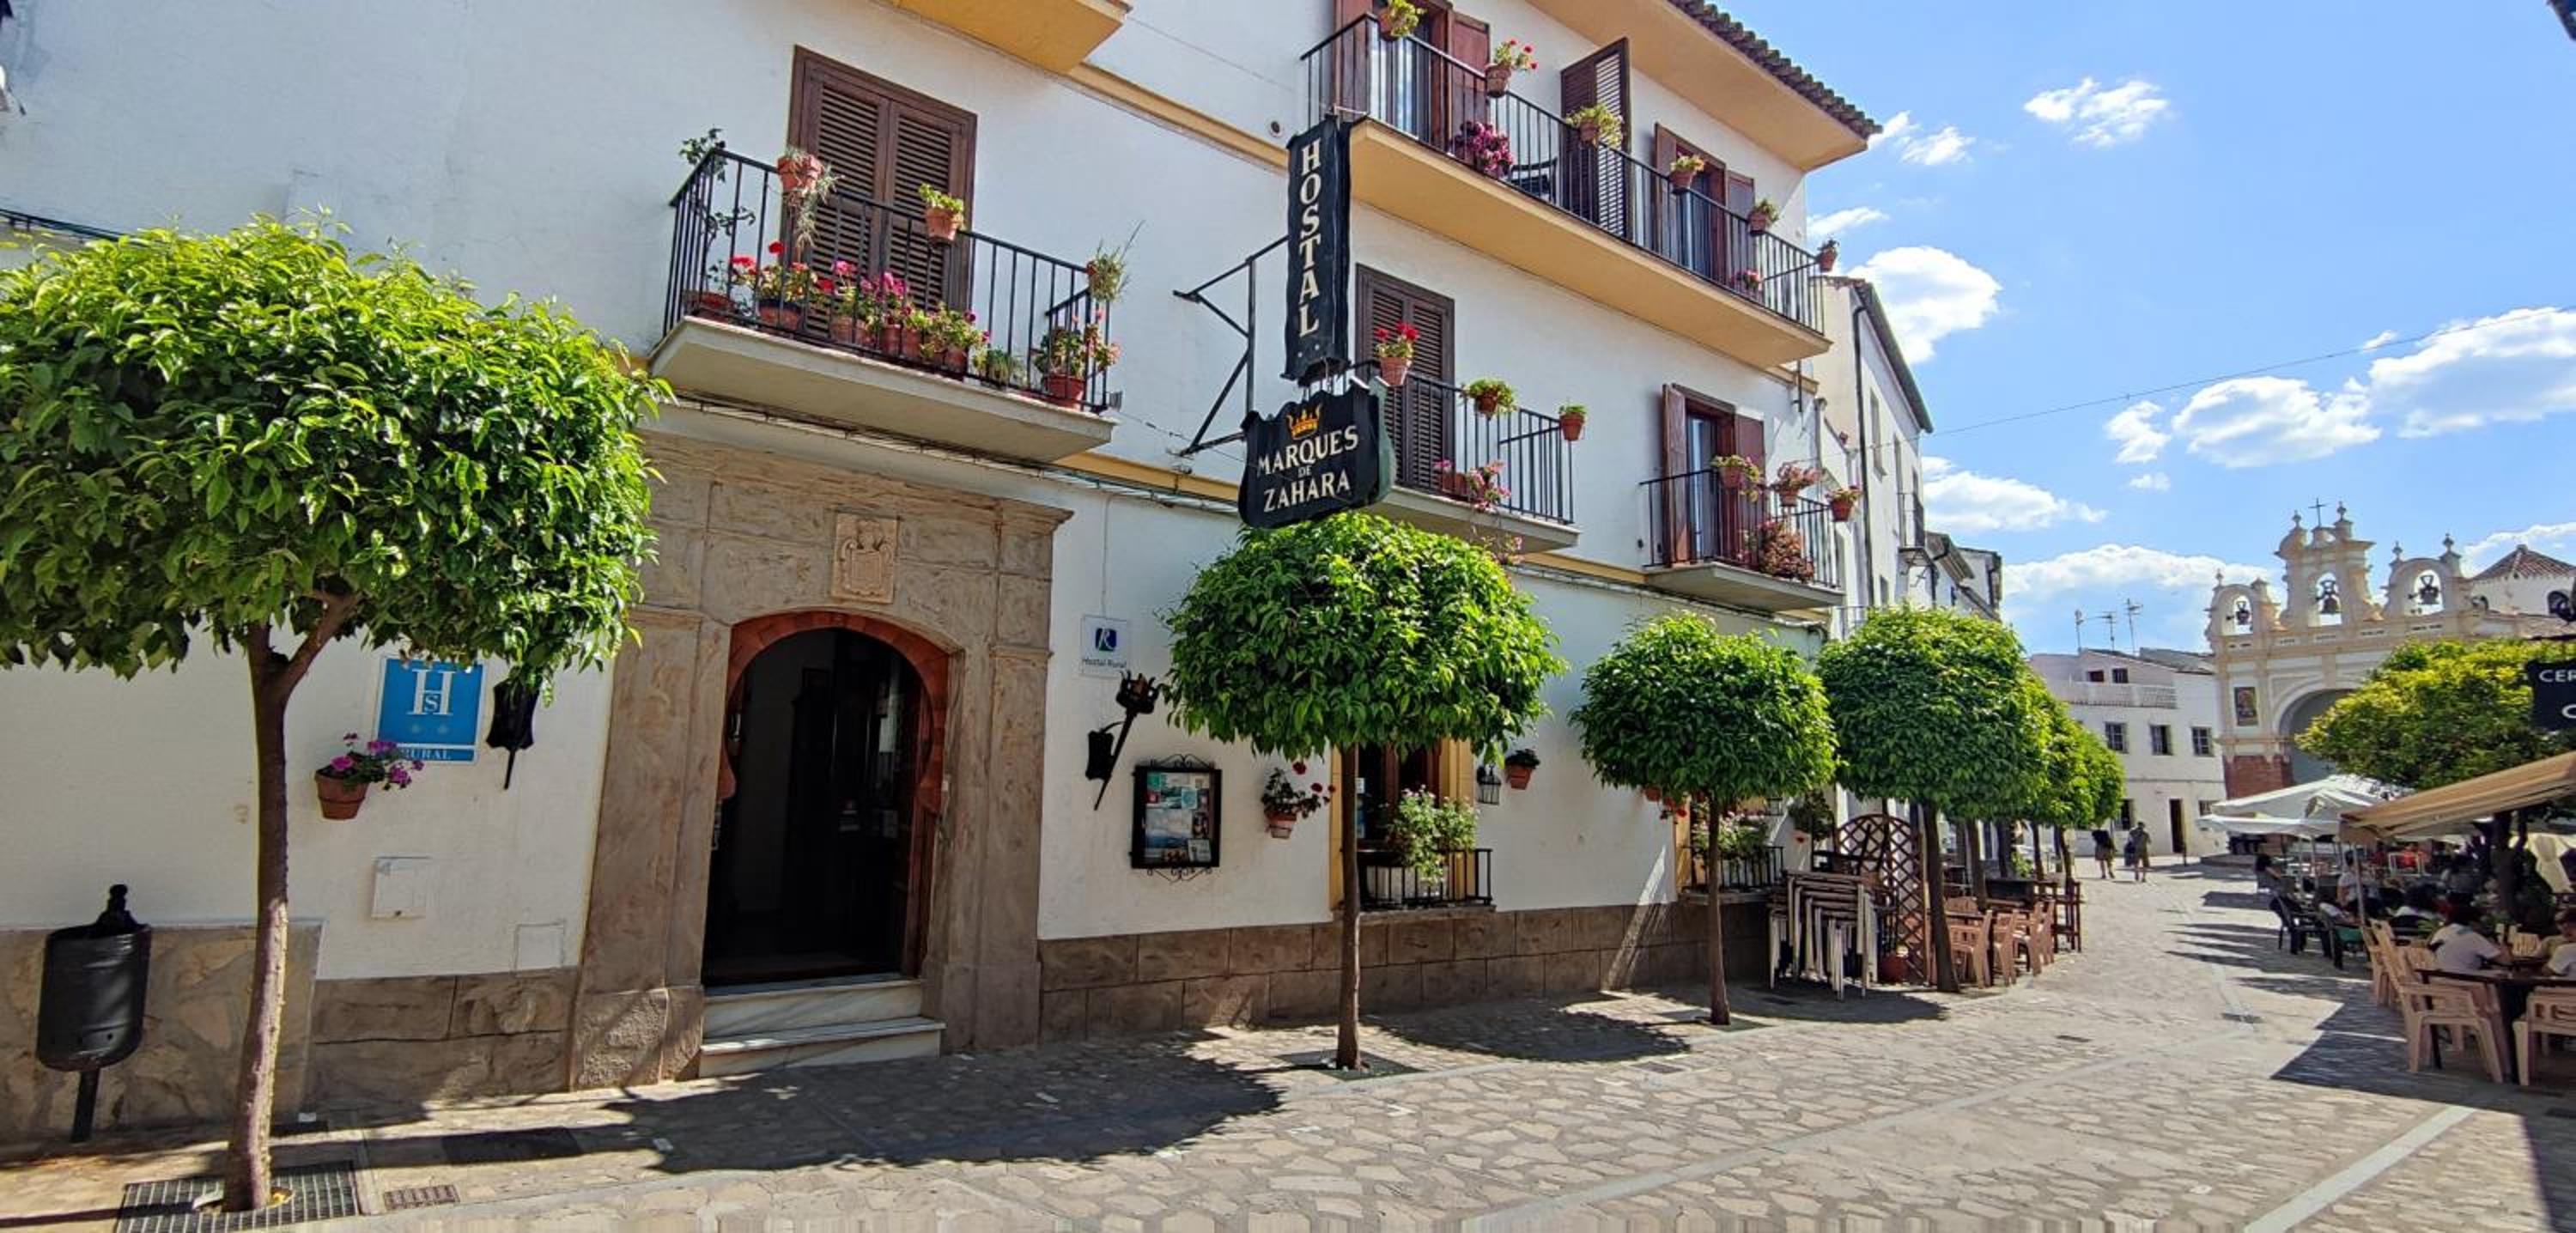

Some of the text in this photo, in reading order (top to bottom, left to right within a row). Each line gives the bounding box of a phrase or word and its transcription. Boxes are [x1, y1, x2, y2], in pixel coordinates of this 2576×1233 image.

[1298, 137, 1322, 338] HOSTAL
[1257, 424, 1359, 477] MARQUES
[1297, 465, 1312, 479] DE
[1263, 467, 1351, 513] ZAHARA
